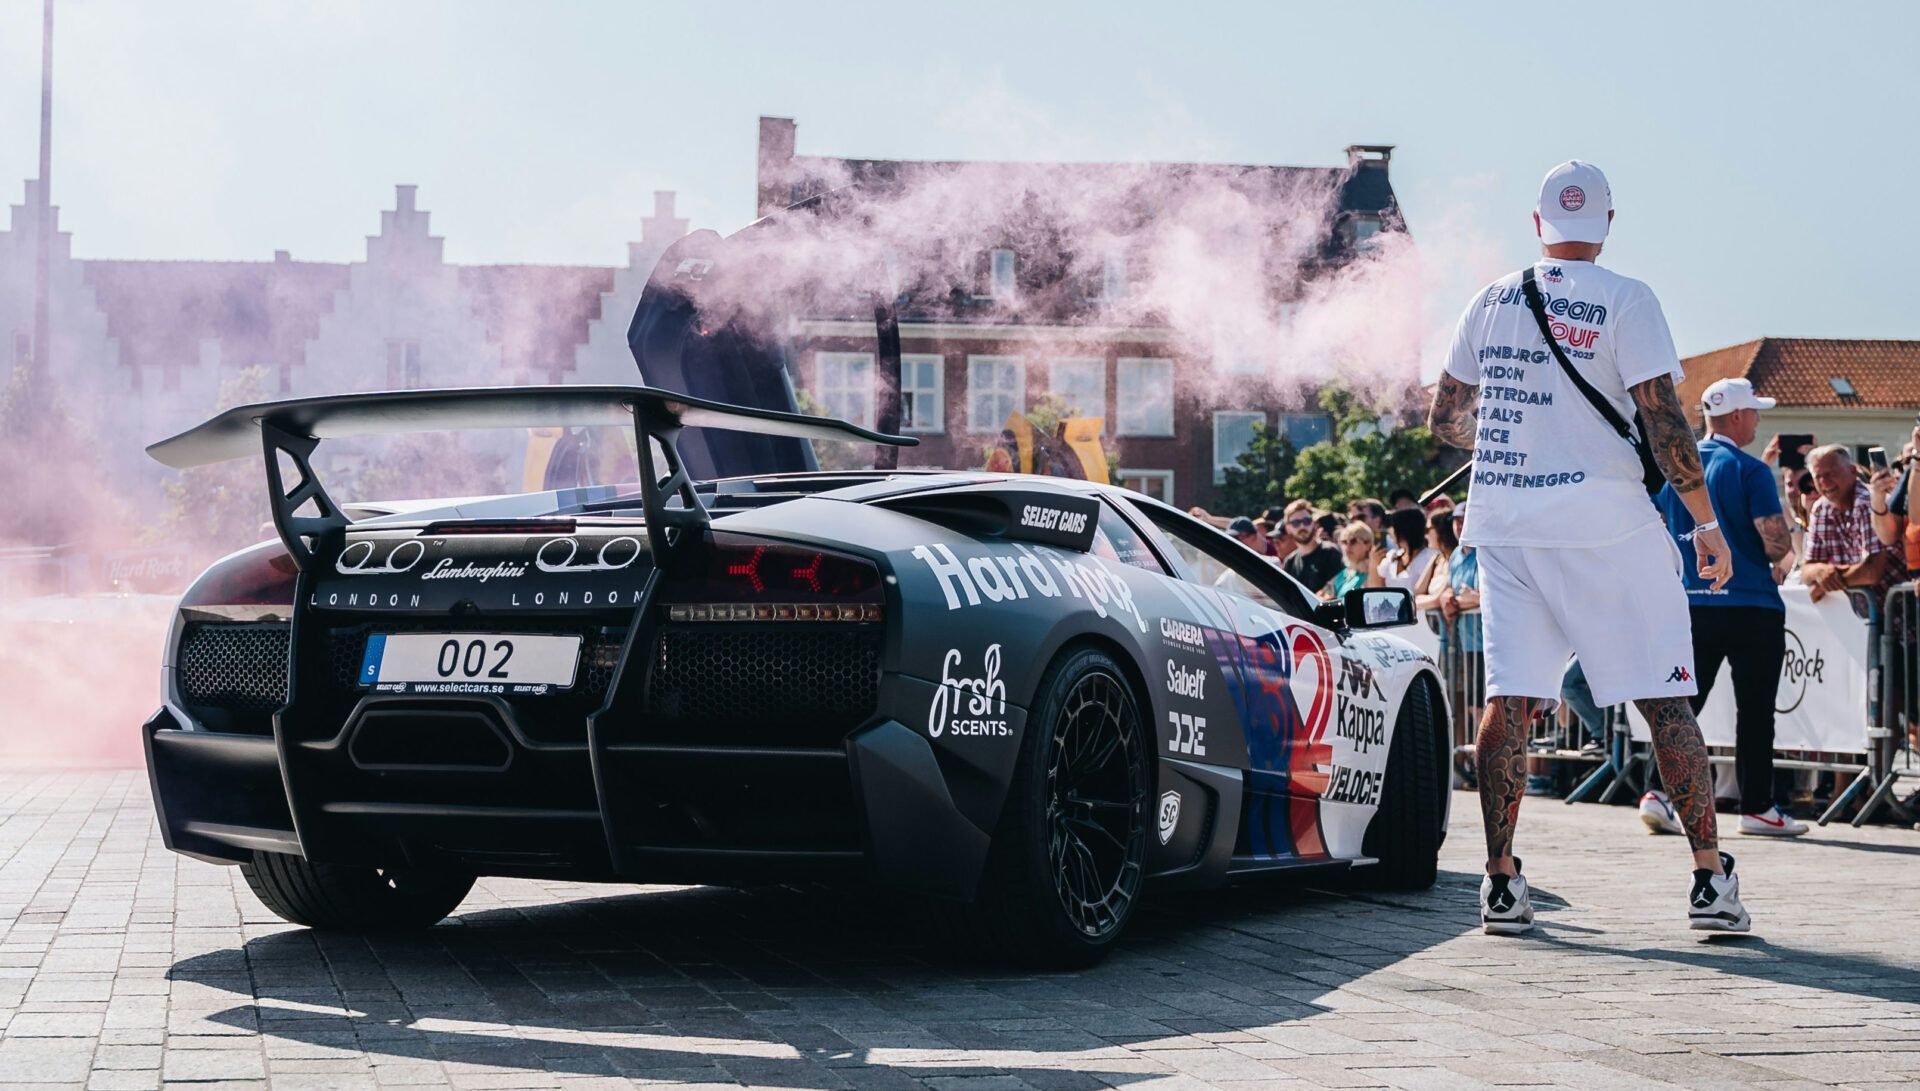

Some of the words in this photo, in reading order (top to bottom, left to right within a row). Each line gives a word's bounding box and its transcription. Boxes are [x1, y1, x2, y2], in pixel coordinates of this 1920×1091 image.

[1484, 386, 1553, 406] STERDAM
[1474, 471, 1586, 488] MONTENEGRO
[1021, 505, 1061, 529] SELECT
[1058, 511, 1088, 534] CARS
[421, 558, 529, 583] Lamborghini
[310, 593, 420, 607] LONDON
[512, 591, 643, 606] LONDON
[911, 543, 1061, 610] Hard
[1033, 545, 1147, 633] Rock
[1160, 617, 1205, 648] CARRERA
[367, 665, 375, 675] S
[437, 639, 514, 678] 002
[1784, 649, 1824, 684] Rock
[415, 683, 504, 693] www.selectcars.se
[928, 643, 1006, 738] frsh
[1167, 659, 1206, 700] Sabelt
[1336, 693, 1385, 754] Kappa
[1161, 803, 1176, 823] SC
